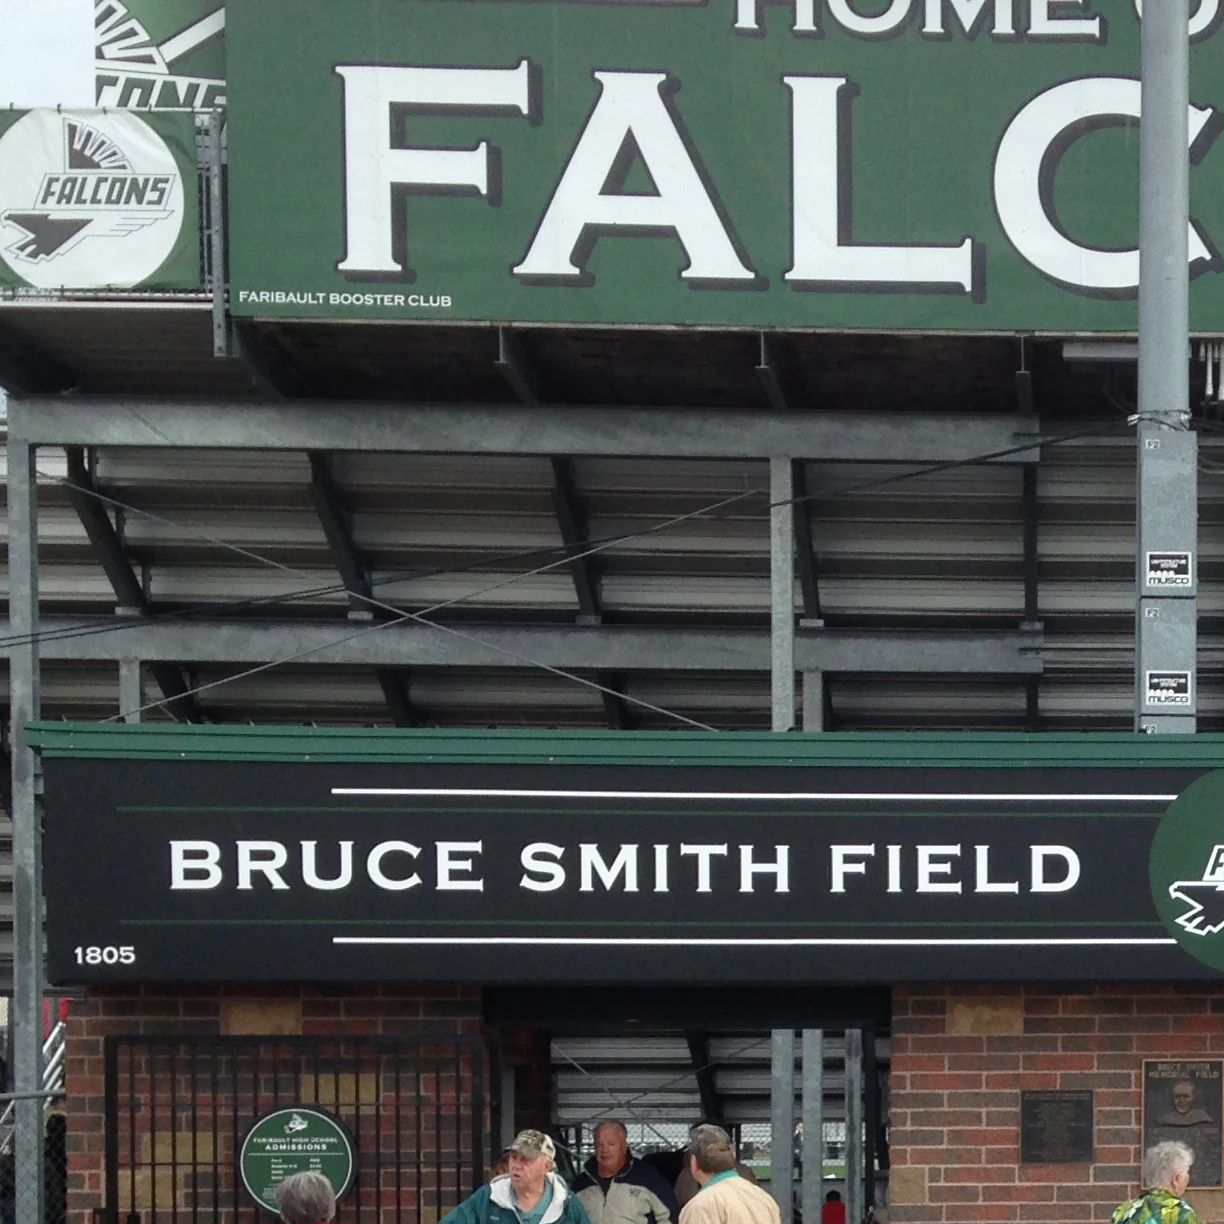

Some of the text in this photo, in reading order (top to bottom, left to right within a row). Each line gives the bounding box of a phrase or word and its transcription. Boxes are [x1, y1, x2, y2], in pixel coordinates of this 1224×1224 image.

[41, 176, 170, 205] FALCONS
[239, 290, 453, 307] FARIBAULT BOOSTER CLUB
[169, 840, 1081, 893] BRUCE SMITH FIELD
[74, 946, 136, 964] 1805
